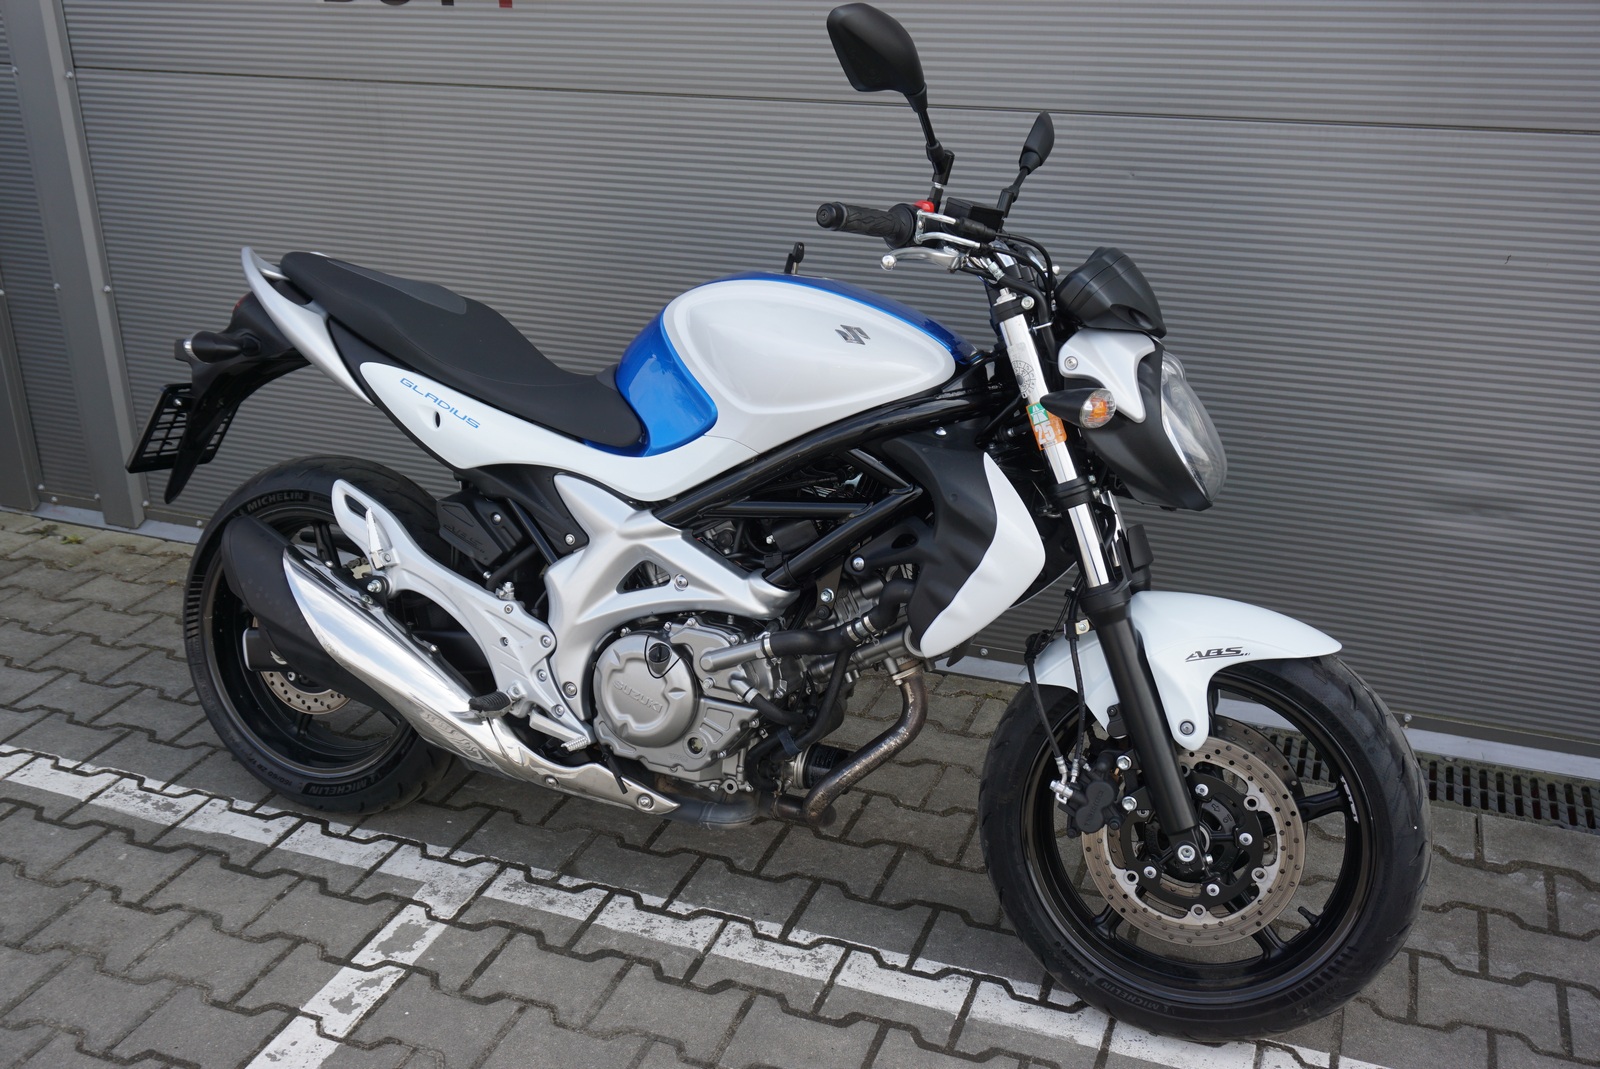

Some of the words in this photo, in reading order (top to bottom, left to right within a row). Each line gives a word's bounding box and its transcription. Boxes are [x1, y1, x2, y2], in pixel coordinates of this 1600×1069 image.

[400, 377, 481, 429] GLADIUS
[1034, 421, 1056, 446] 25
[246, 491, 304, 512] MICHELIN
[1185, 646, 1244, 662] ABS
[613, 679, 663, 714] SUZUKI
[308, 779, 368, 796] MICHELIN
[1100, 981, 1160, 1010] MICHELIN
